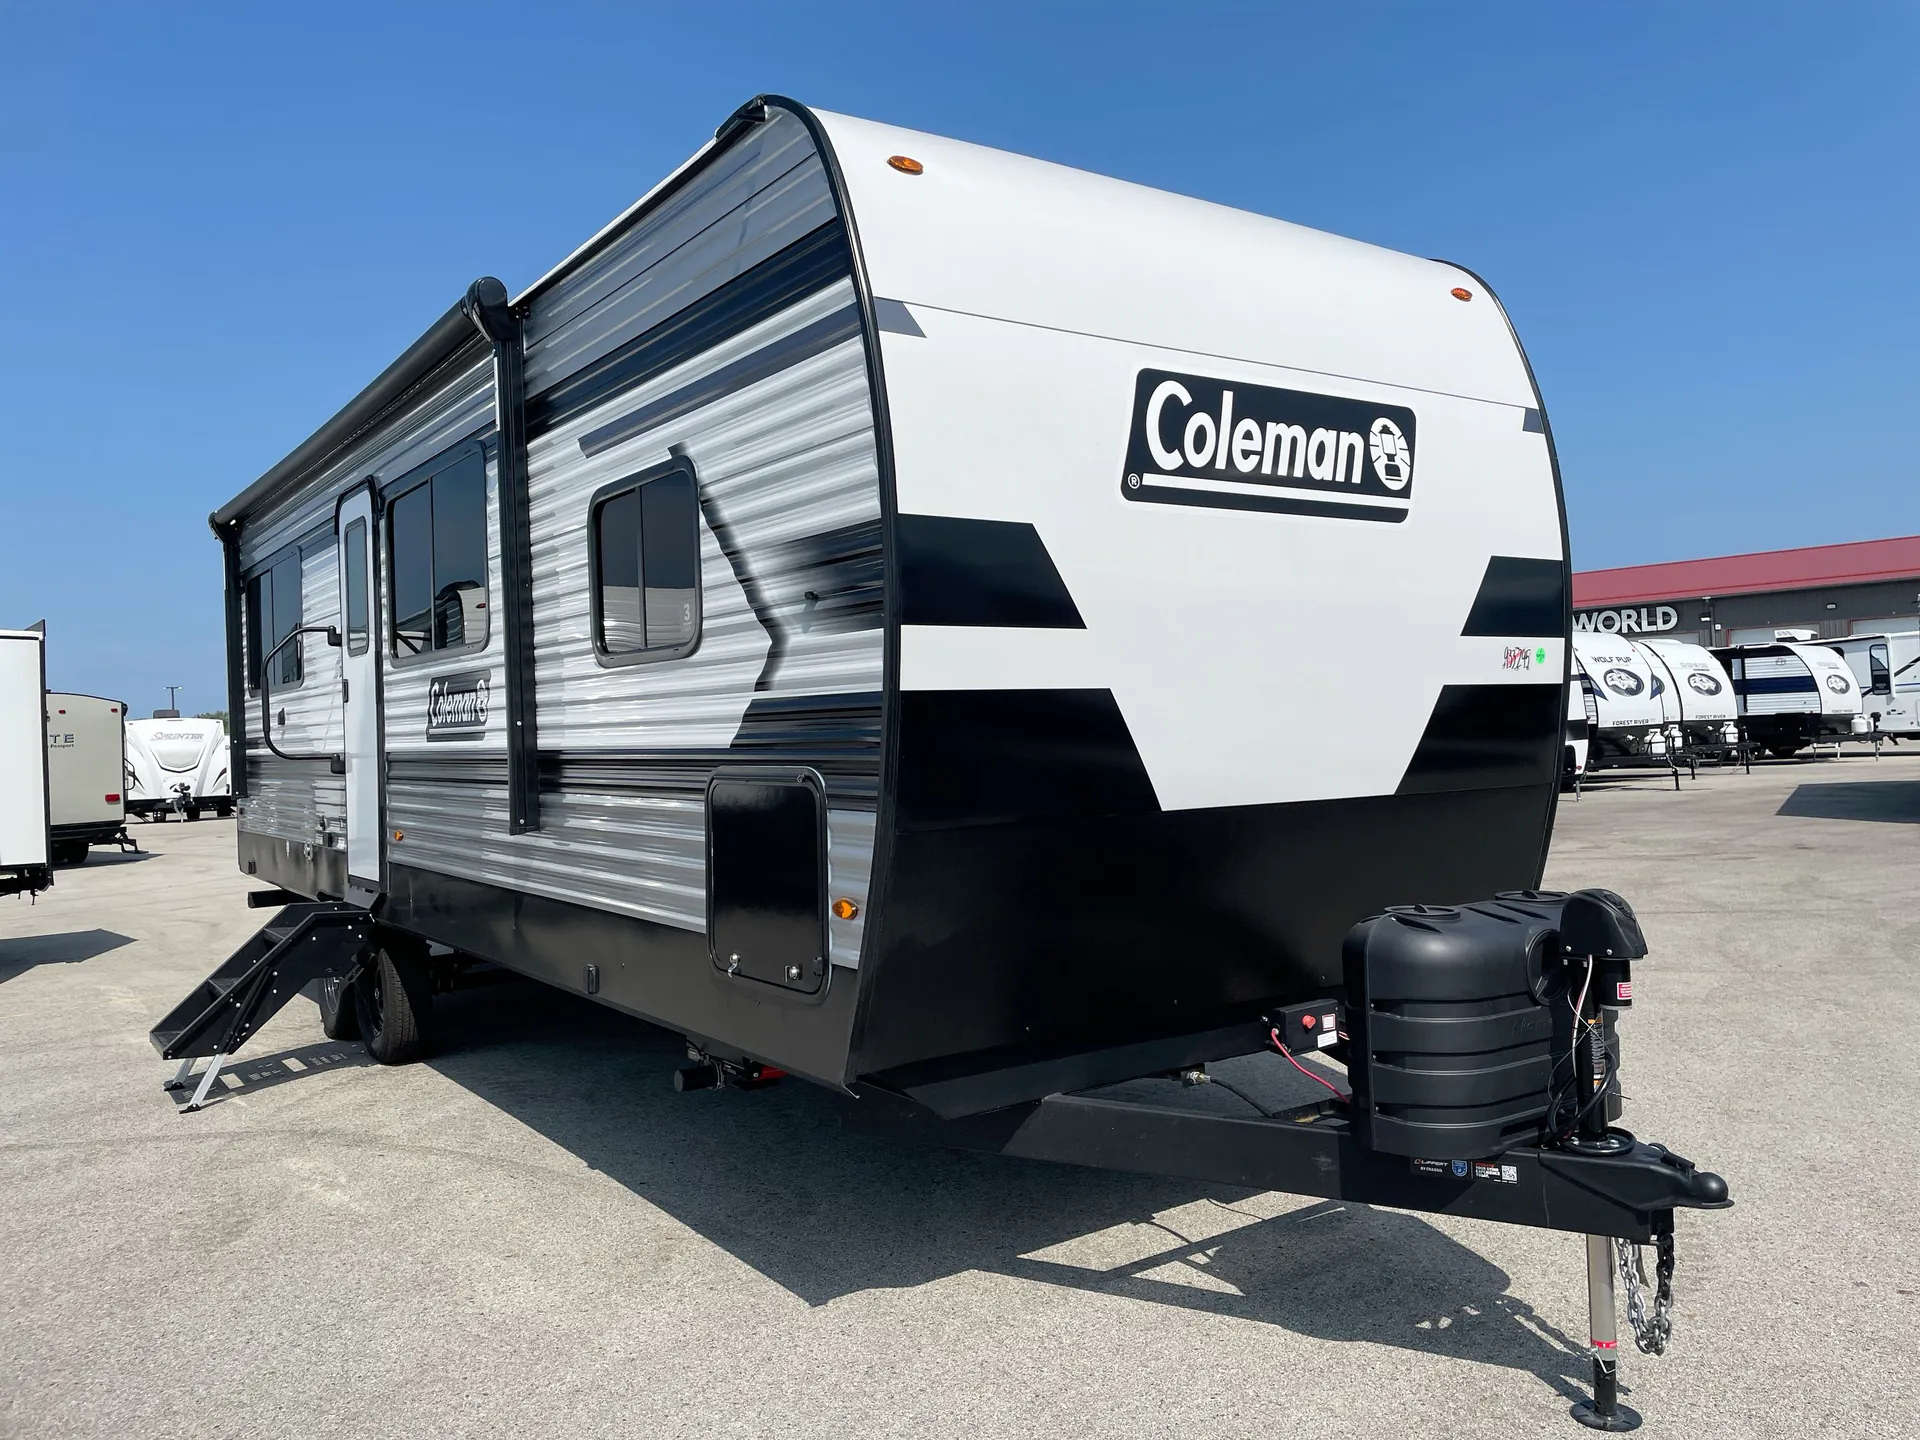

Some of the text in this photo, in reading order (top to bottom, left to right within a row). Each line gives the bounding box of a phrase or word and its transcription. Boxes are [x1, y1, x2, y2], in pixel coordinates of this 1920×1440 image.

[1146, 380, 1364, 484] Coleman
[1572, 606, 1678, 634] WORLD
[430, 682, 477, 727] Coleman
[49, 733, 75, 743] TE
